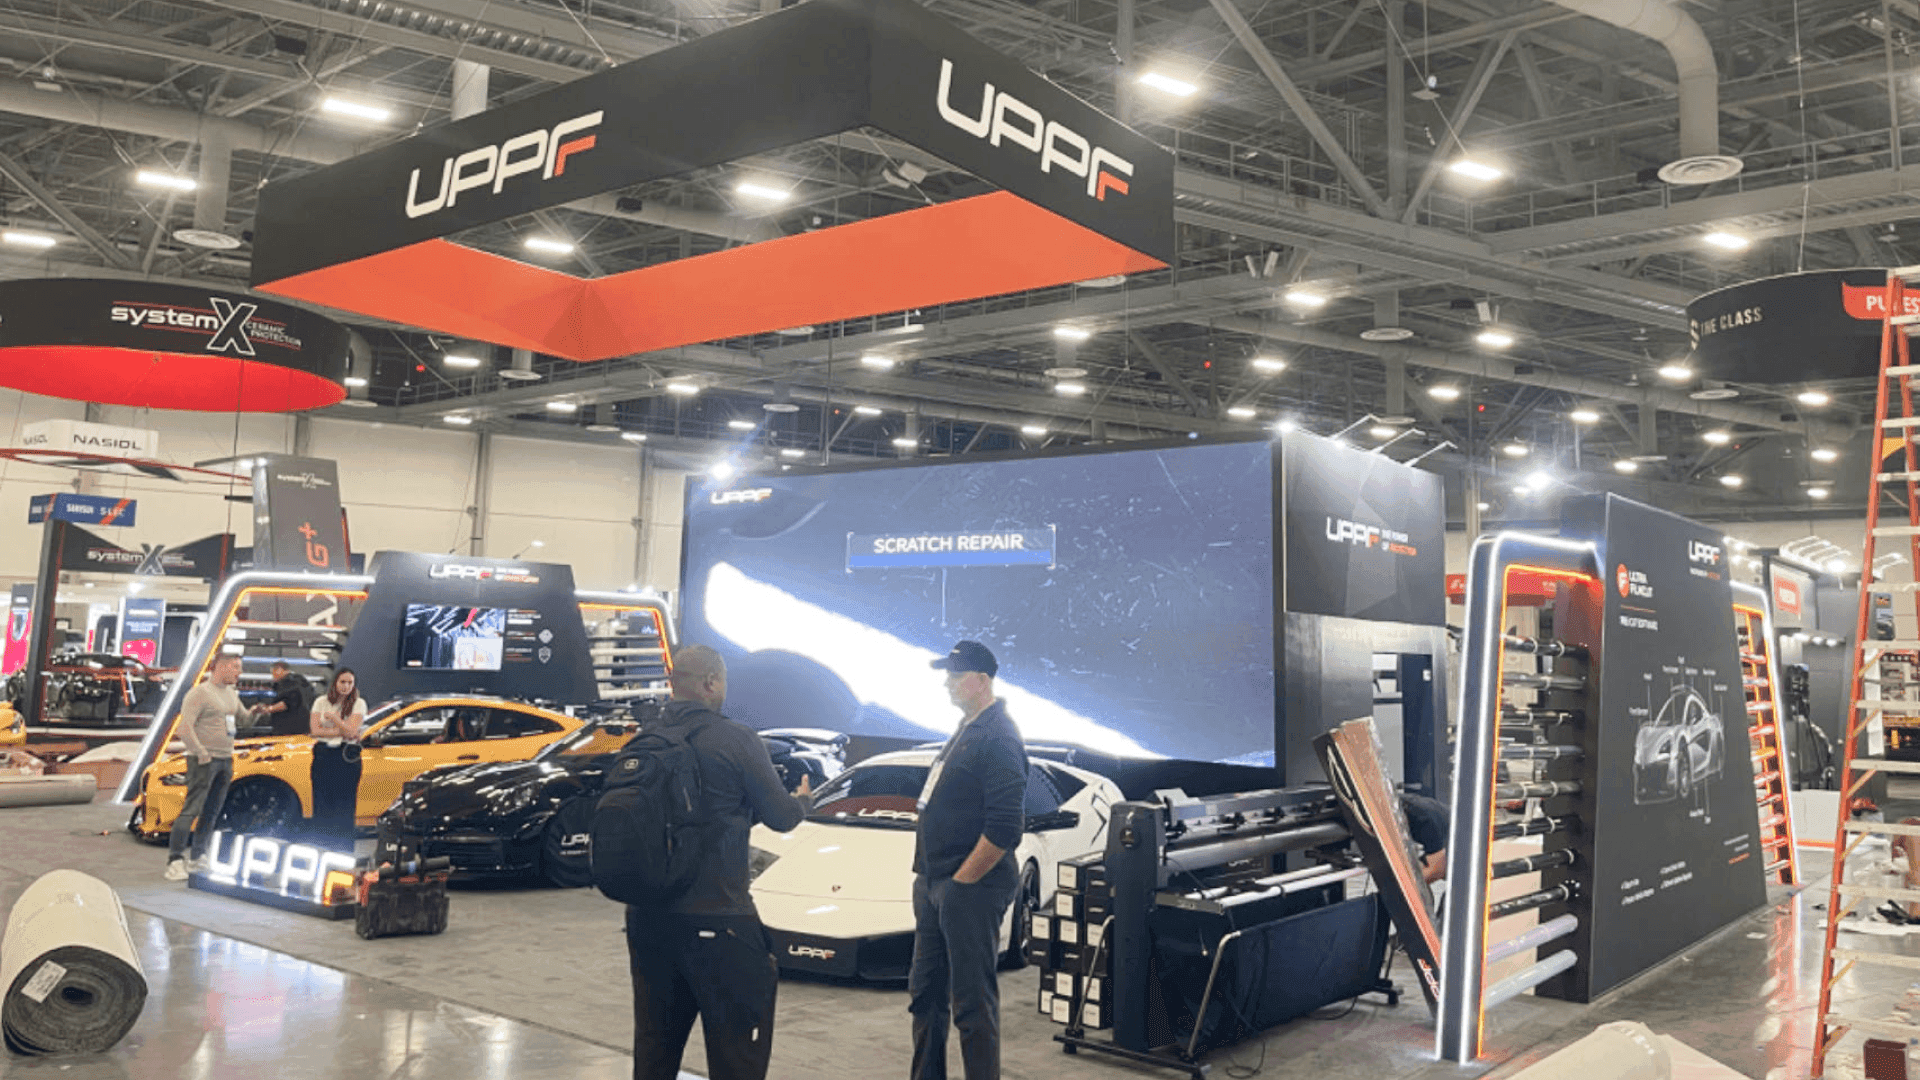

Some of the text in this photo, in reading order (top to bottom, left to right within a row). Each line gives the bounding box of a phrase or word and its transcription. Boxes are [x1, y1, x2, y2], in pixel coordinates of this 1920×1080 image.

[936, 57, 1134, 202] UPPF
[405, 110, 604, 218] UPPF
[1719, 306, 1764, 331] CLASS
[1866, 294, 1920, 314] PUES
[873, 533, 1025, 554] SCRATCH REPAIR
[207, 829, 358, 906] UPPF
